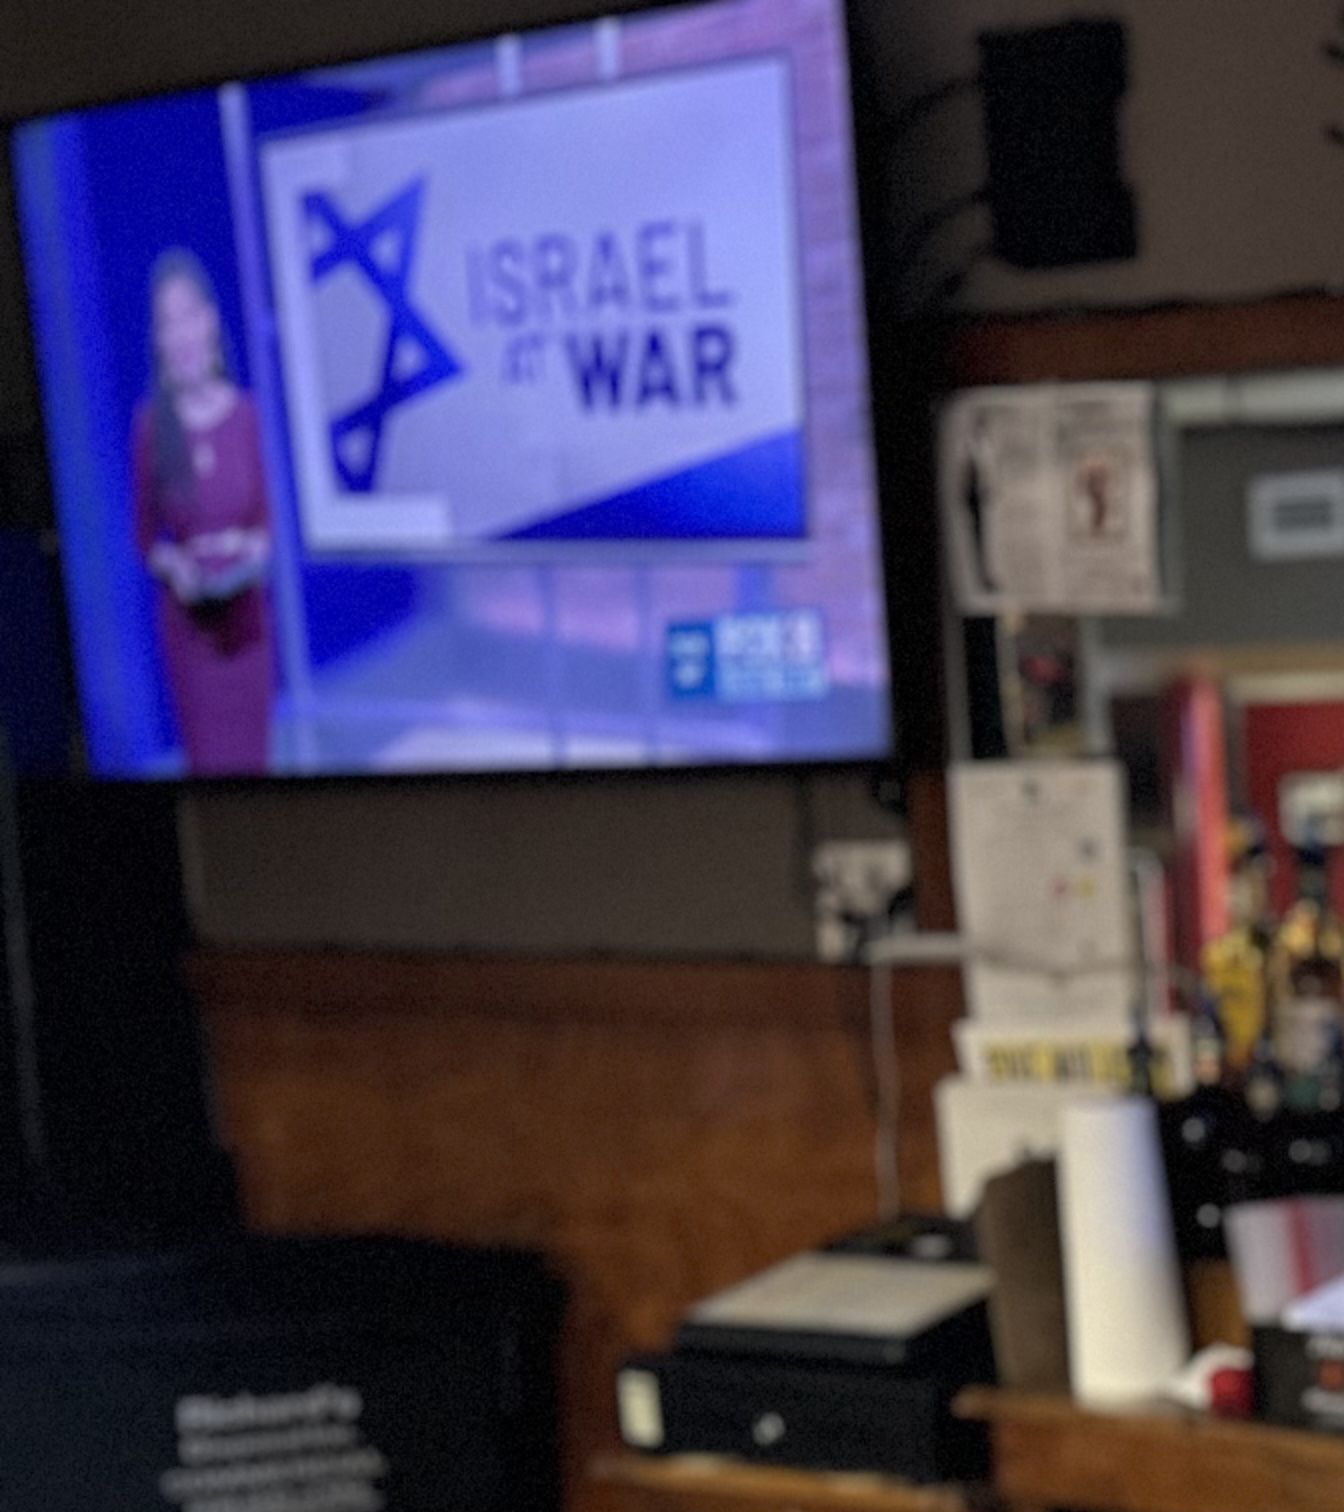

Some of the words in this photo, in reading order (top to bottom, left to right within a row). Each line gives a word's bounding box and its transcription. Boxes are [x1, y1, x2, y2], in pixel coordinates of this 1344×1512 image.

[464, 218, 738, 326] ISRAEL
[504, 334, 546, 386] AT
[564, 322, 740, 413] WAR
